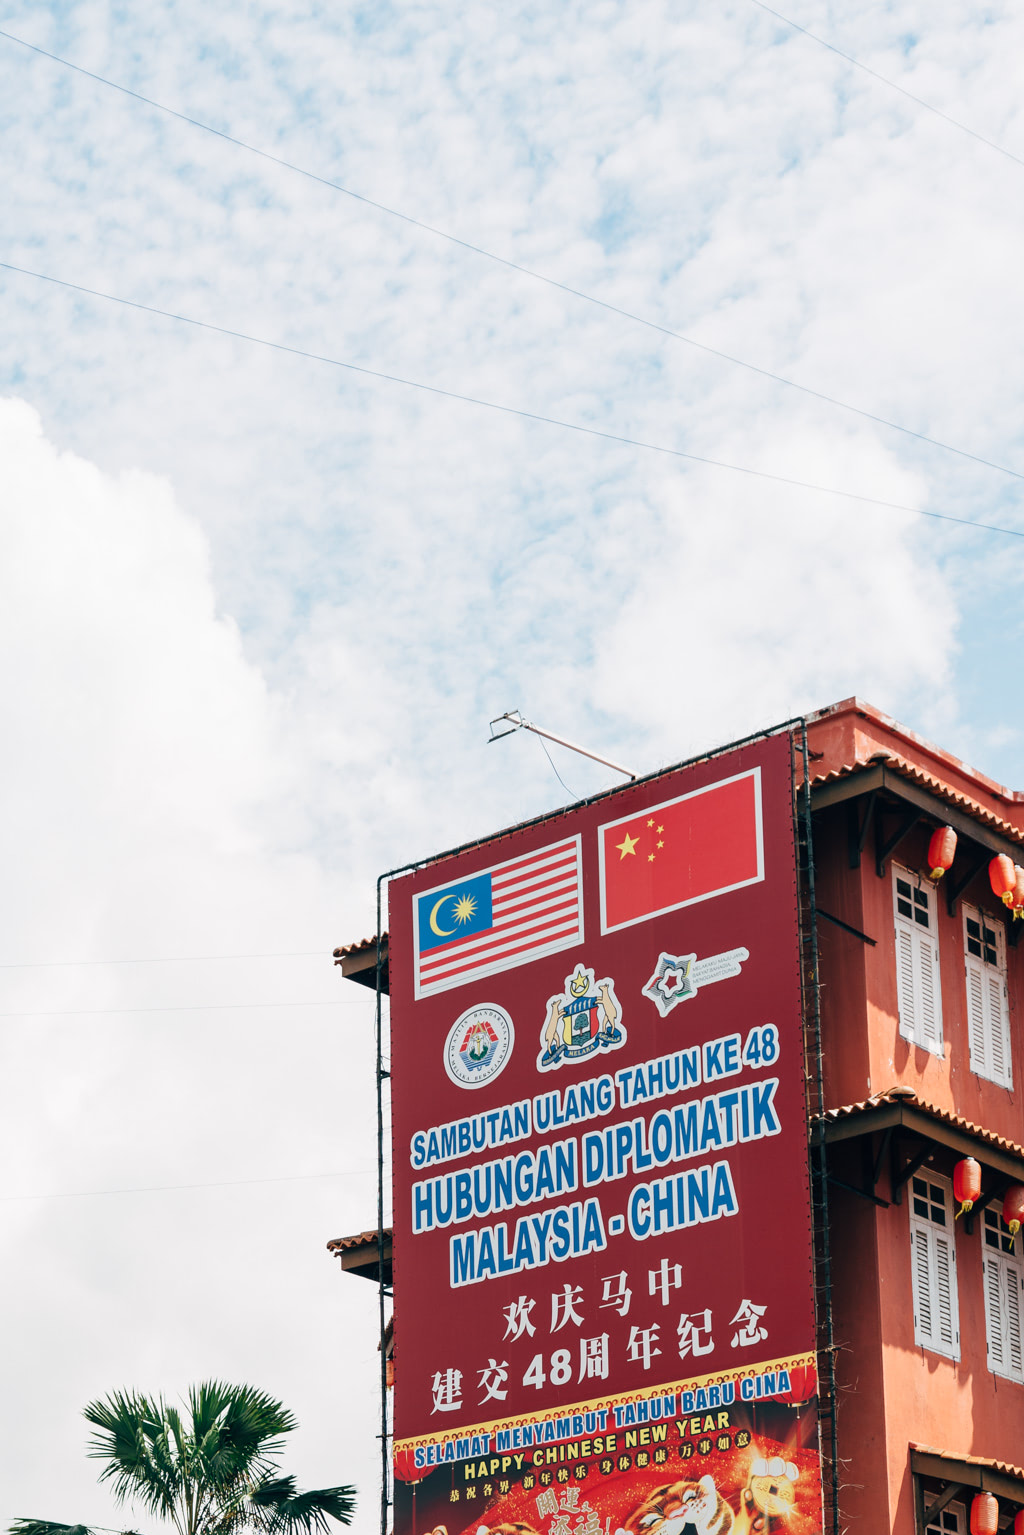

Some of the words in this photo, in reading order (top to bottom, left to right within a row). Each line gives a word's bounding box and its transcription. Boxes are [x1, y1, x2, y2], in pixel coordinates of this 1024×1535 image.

[413, 1103, 529, 1166] SAMBUTAN
[535, 1078, 612, 1130] ULANG
[618, 1050, 698, 1104] TAHUN
[705, 1037, 739, 1080] KE
[745, 1027, 777, 1066] 48
[568, 1045, 595, 1056] MELAKA
[414, 1140, 577, 1232] HUBUNGAN
[585, 1082, 778, 1184] DIPLOMATIK
[452, 1201, 605, 1285] MALAYSIA
[631, 1163, 736, 1239] CHINA
[502, 1258, 683, 1343] 欢庆马中
[430, 1299, 769, 1416] 建交48周年纪念
[414, 1433, 491, 1468] SELAMAT
[496, 1409, 608, 1452] MENYAMBUT
[614, 1394, 676, 1428] TAHUN
[681, 1381, 735, 1414] BARU
[741, 1370, 791, 1401] CINA
[449, 1480, 510, 1502] 恭祝各界
[523, 1465, 588, 1490] 新年快乐
[600, 1449, 667, 1473] 身体健康
[680, 1432, 749, 1458] 万事如意
[464, 1453, 525, 1480] HAPPY
[532, 1434, 617, 1467] CHINESE
[625, 1424, 668, 1449] NEW
[676, 1411, 730, 1438] YEAR
